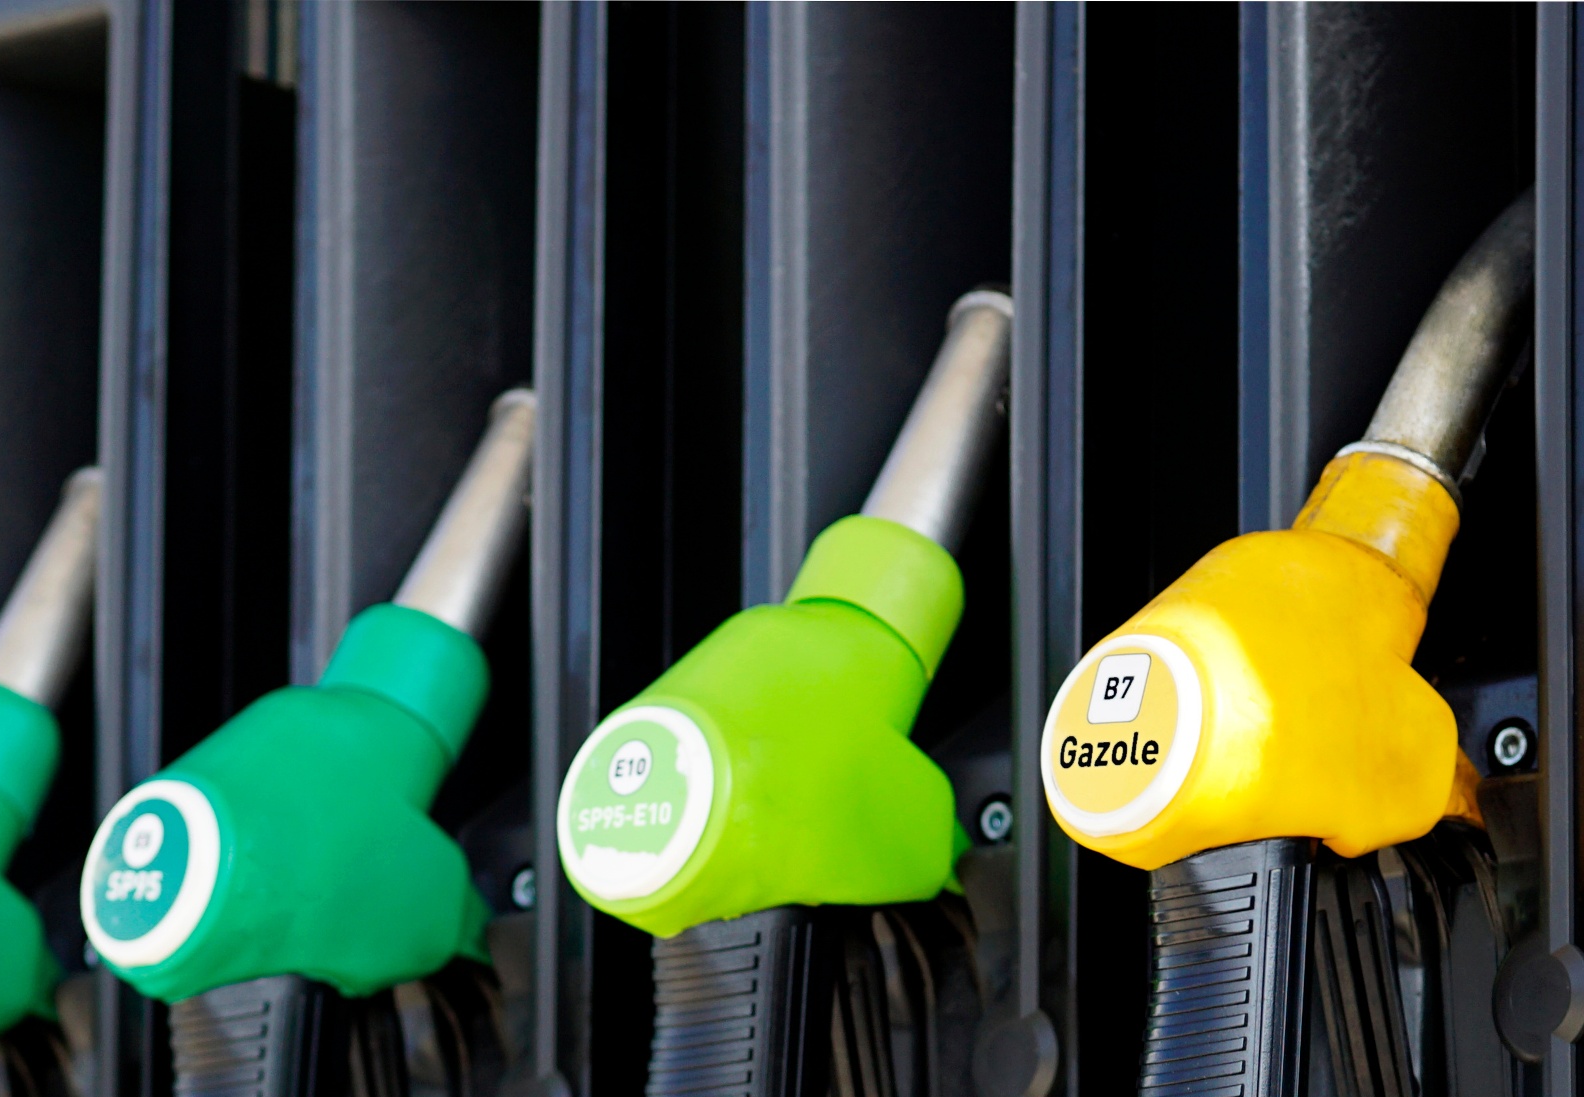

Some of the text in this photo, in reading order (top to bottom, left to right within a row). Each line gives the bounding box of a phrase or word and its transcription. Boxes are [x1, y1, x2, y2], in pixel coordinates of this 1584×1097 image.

[1104, 676, 1134, 700] B7
[1059, 731, 1159, 769] Gazole
[614, 757, 647, 778] E10
[578, 802, 672, 832] SP95-E10
[106, 869, 164, 901] SP95
